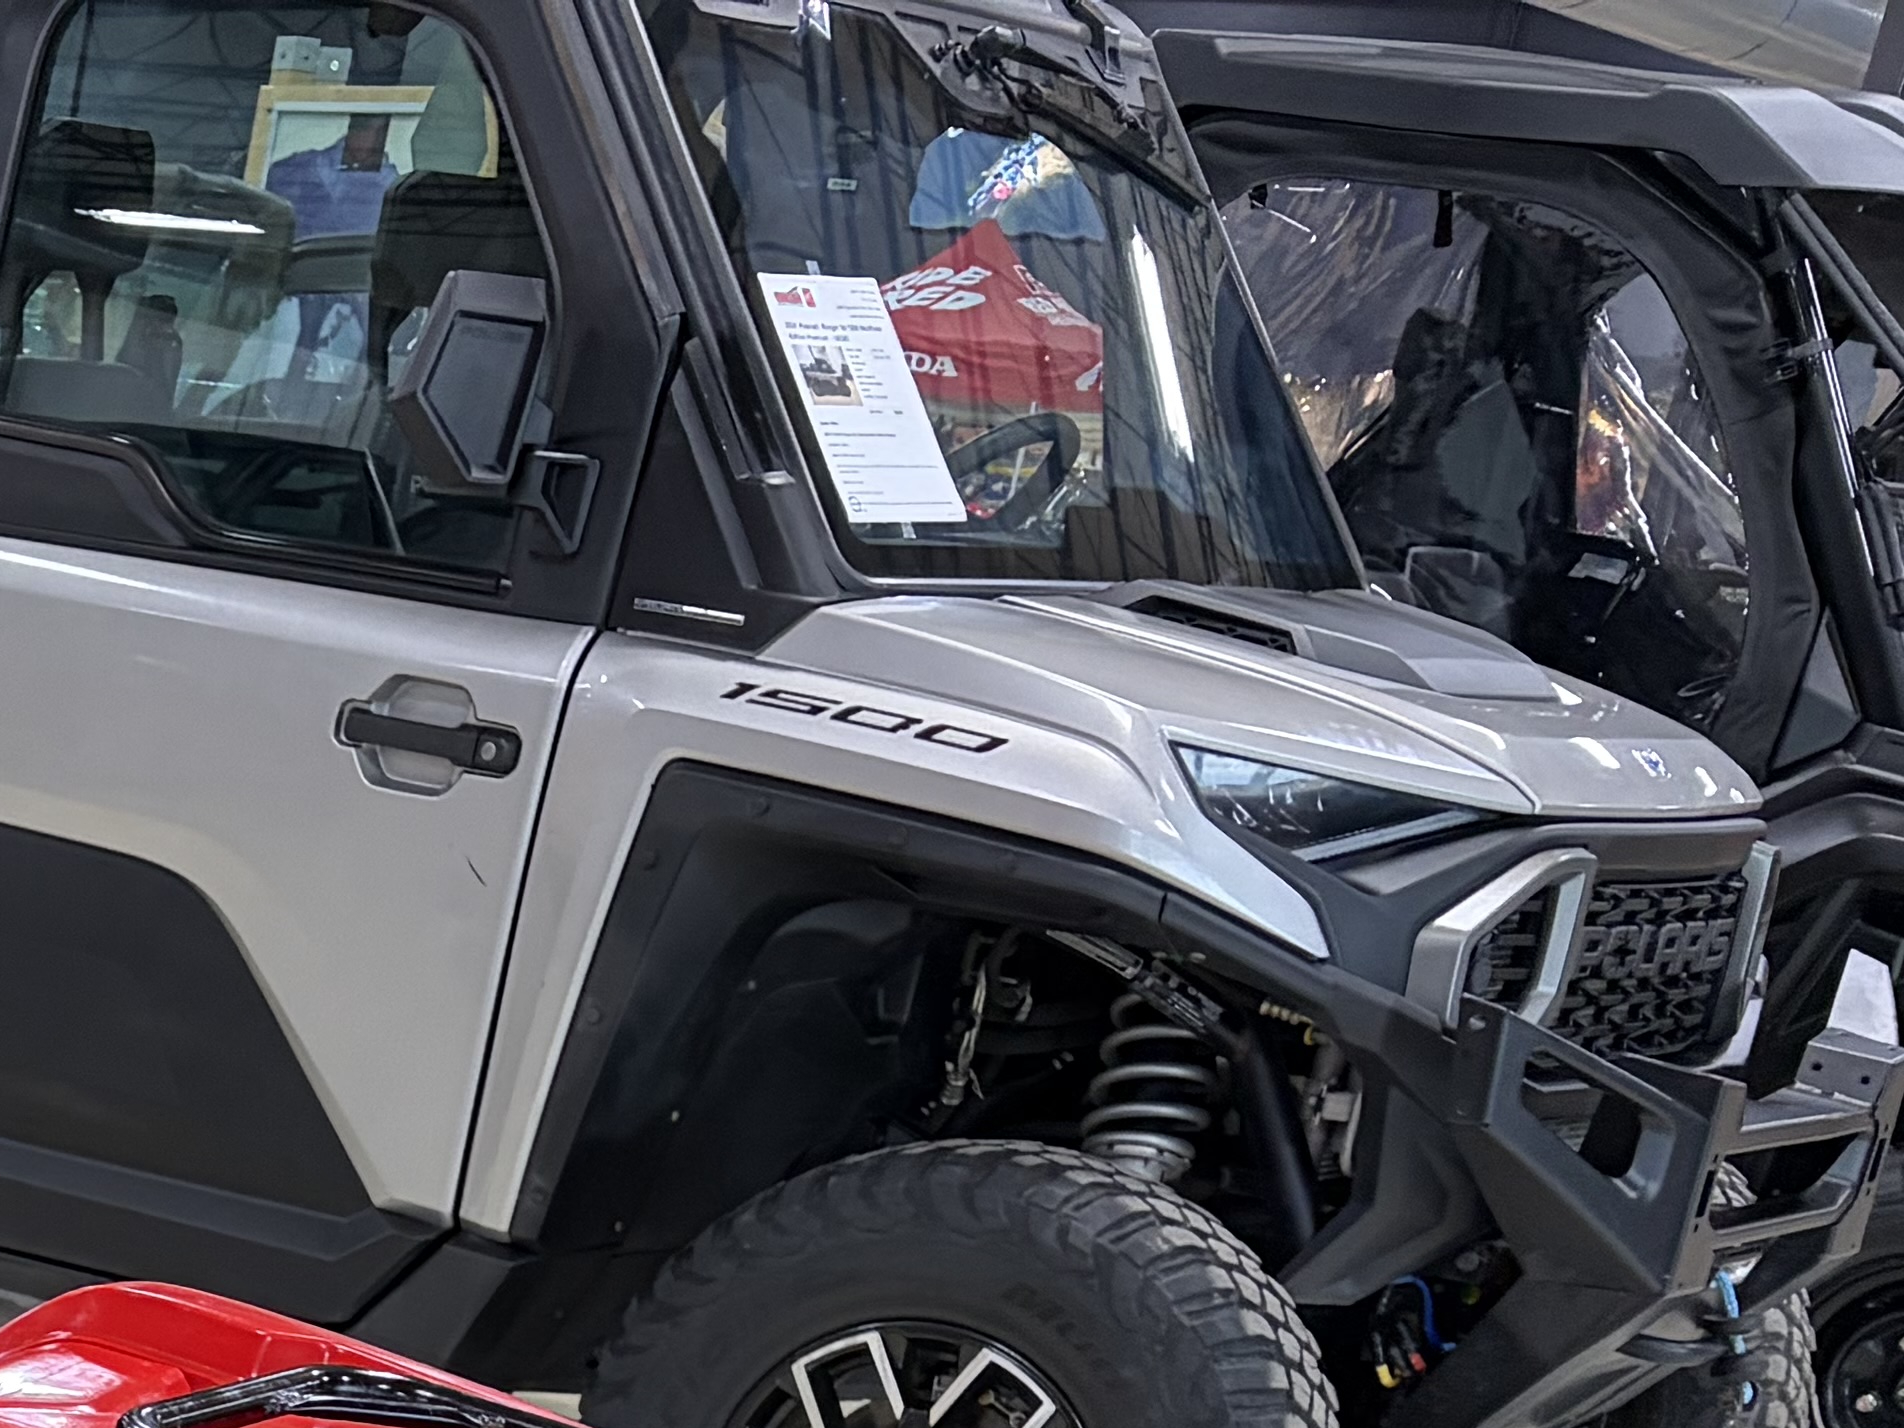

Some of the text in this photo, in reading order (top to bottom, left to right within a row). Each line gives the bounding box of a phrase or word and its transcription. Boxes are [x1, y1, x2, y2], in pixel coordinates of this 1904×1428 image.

[884, 286, 986, 310] RED
[720, 682, 1009, 753] 1500
[1576, 917, 1737, 979] POLARIS
